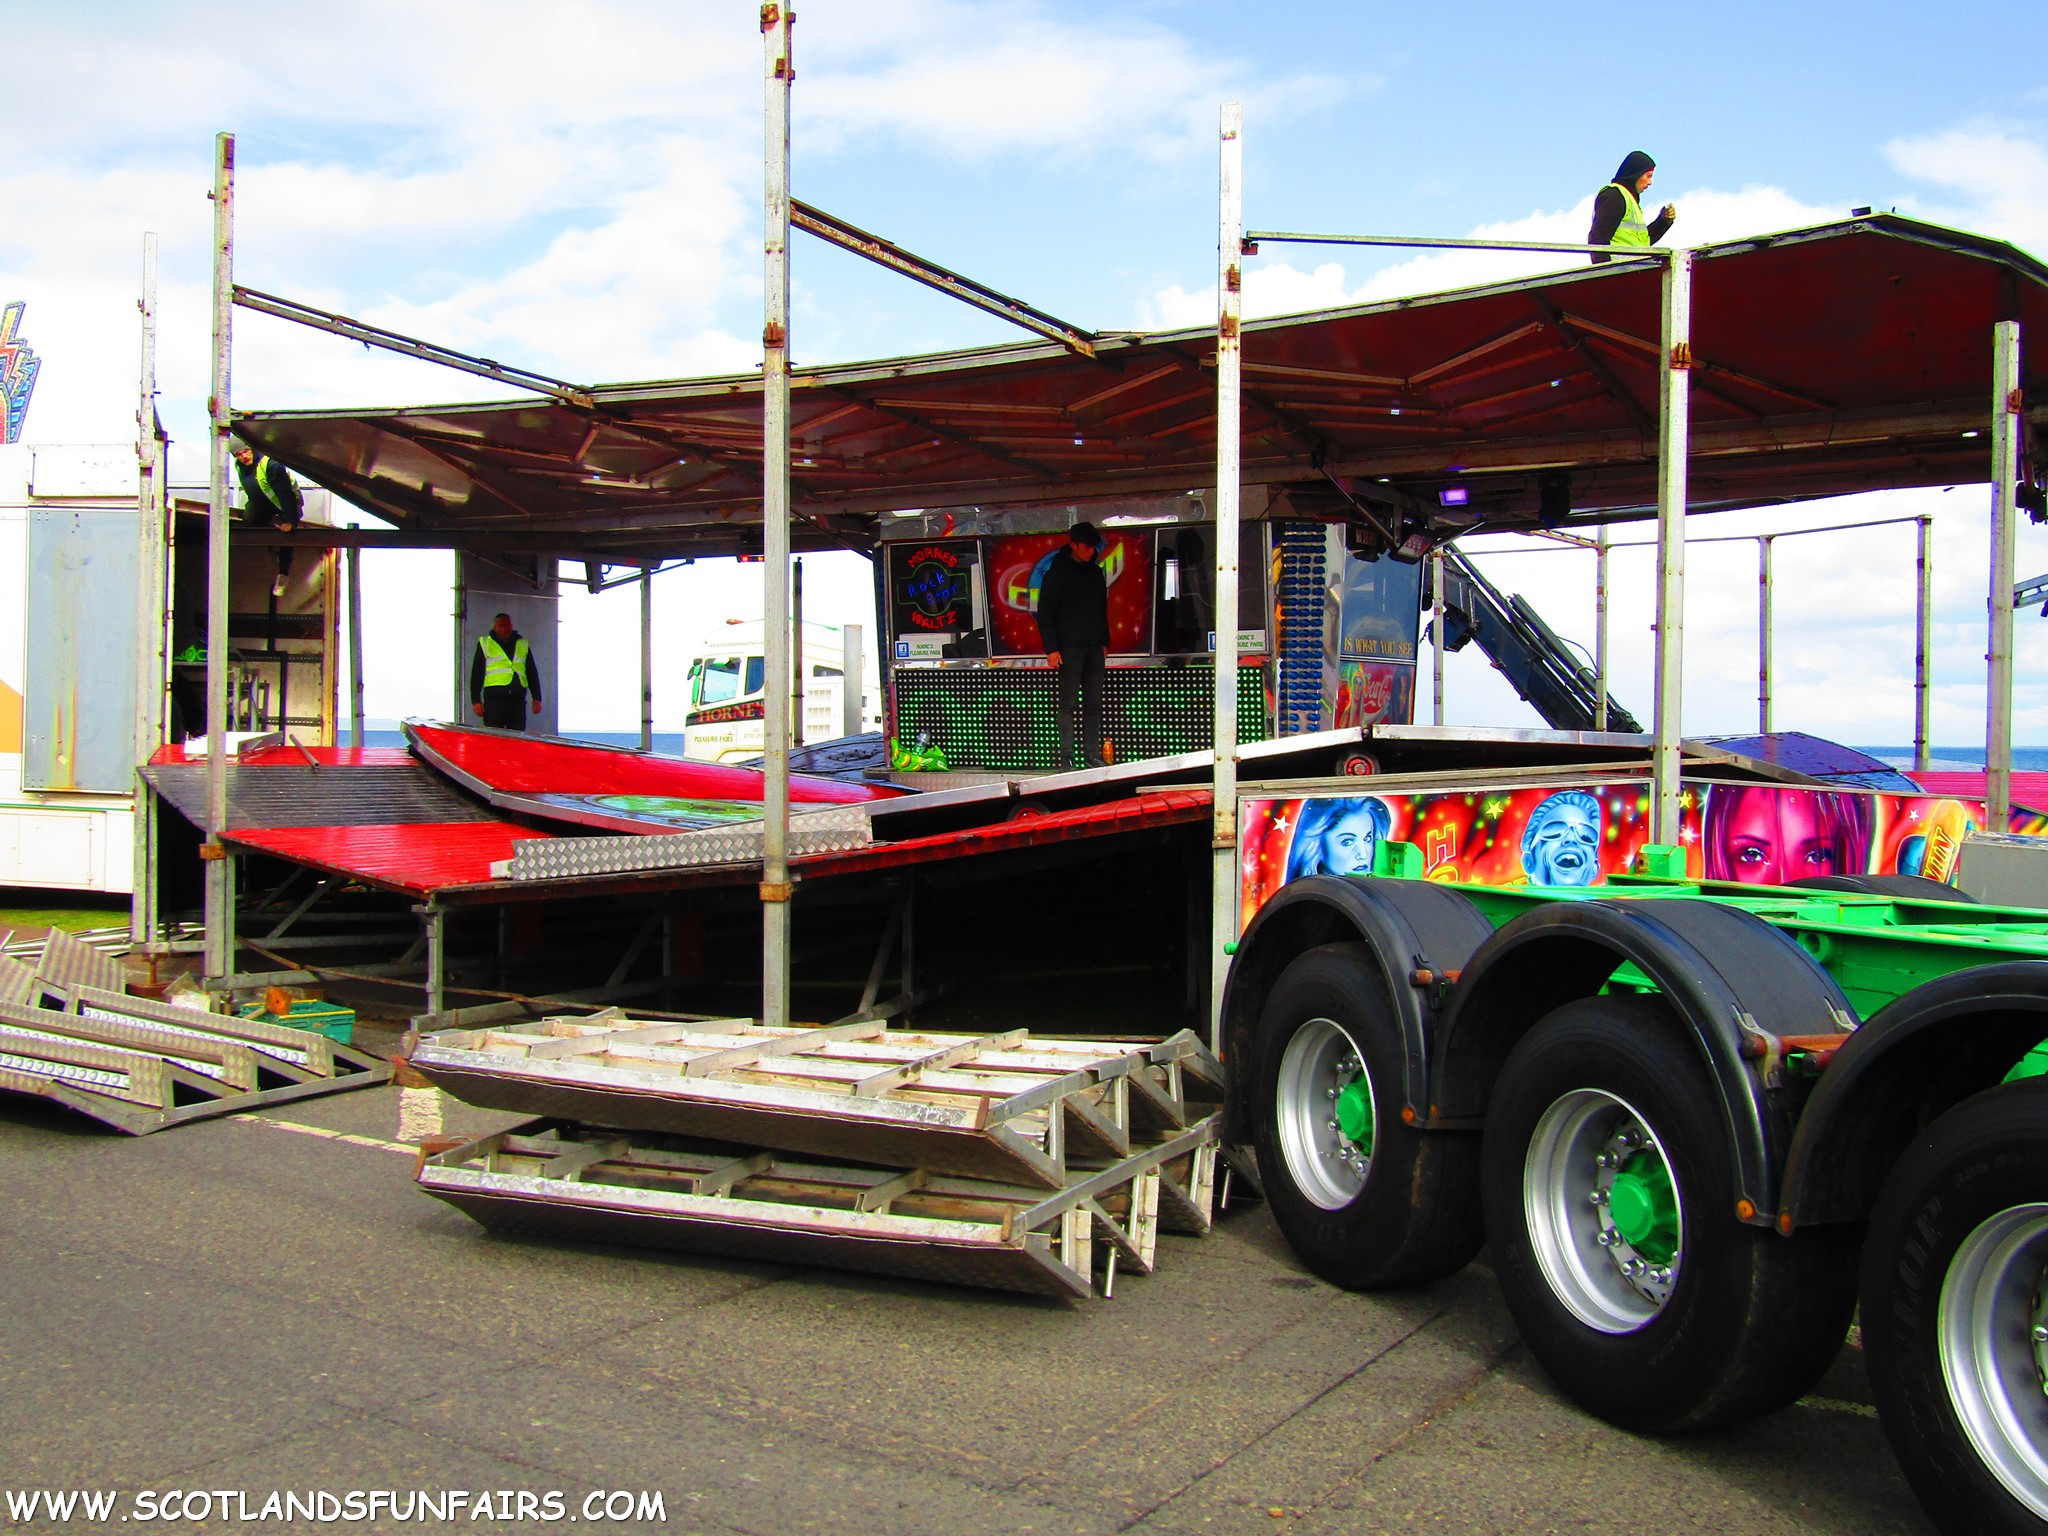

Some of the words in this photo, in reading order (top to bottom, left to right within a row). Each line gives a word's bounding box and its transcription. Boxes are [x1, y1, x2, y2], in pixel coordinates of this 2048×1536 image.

[907, 571, 945, 597] Rock
[1344, 636, 1353, 651] IS
[1355, 638, 1377, 654] WHAT
[1380, 640, 1395, 655] YOU
